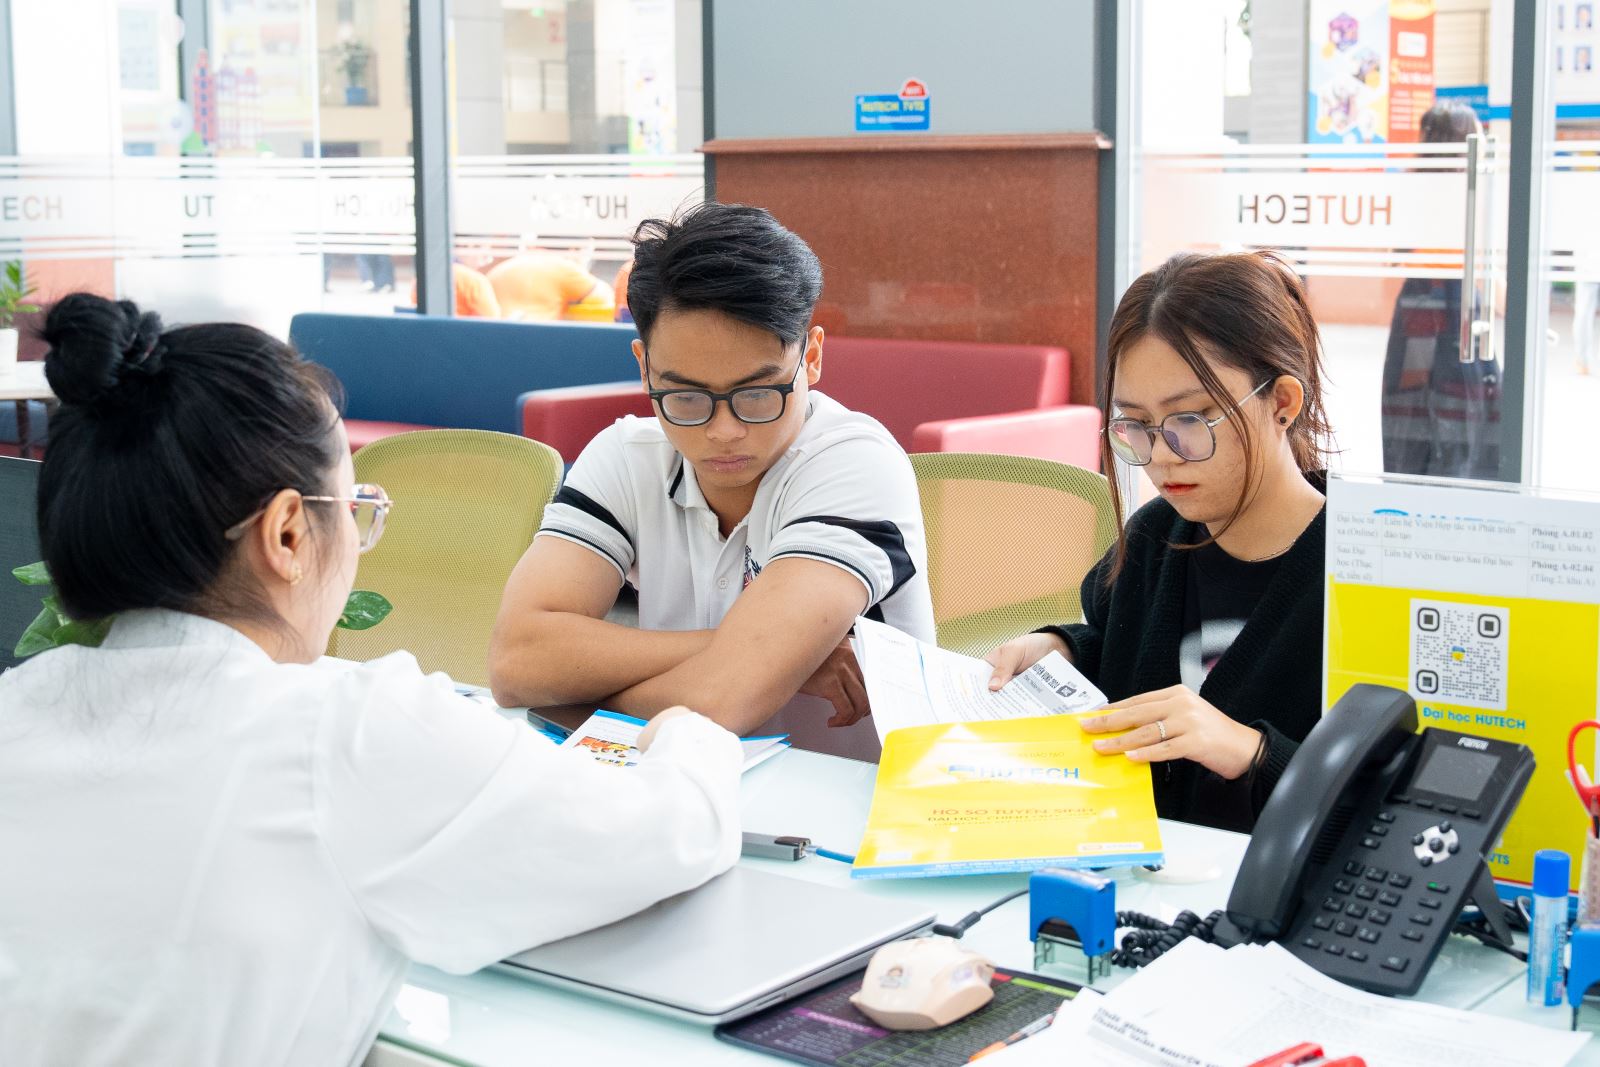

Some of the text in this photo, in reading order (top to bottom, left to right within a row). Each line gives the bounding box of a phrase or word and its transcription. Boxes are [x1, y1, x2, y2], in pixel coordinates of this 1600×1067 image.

[1423, 706, 1526, 731] Đại học HUTECH
